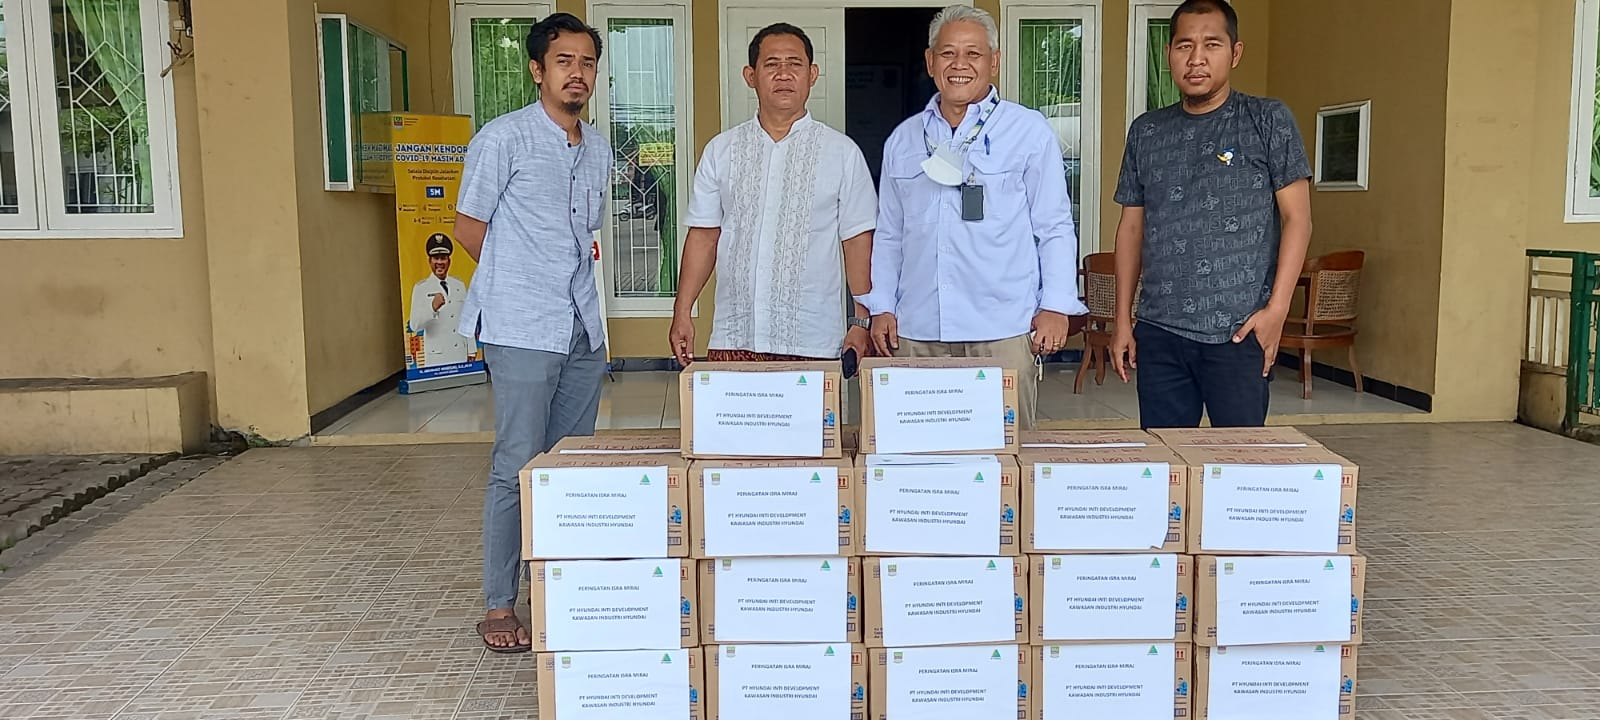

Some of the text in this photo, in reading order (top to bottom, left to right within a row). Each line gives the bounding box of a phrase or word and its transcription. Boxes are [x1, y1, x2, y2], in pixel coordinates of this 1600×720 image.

[395, 144, 432, 153] JANGAN
[434, 145, 468, 154] KENDOR
[430, 188, 441, 196] 5M
